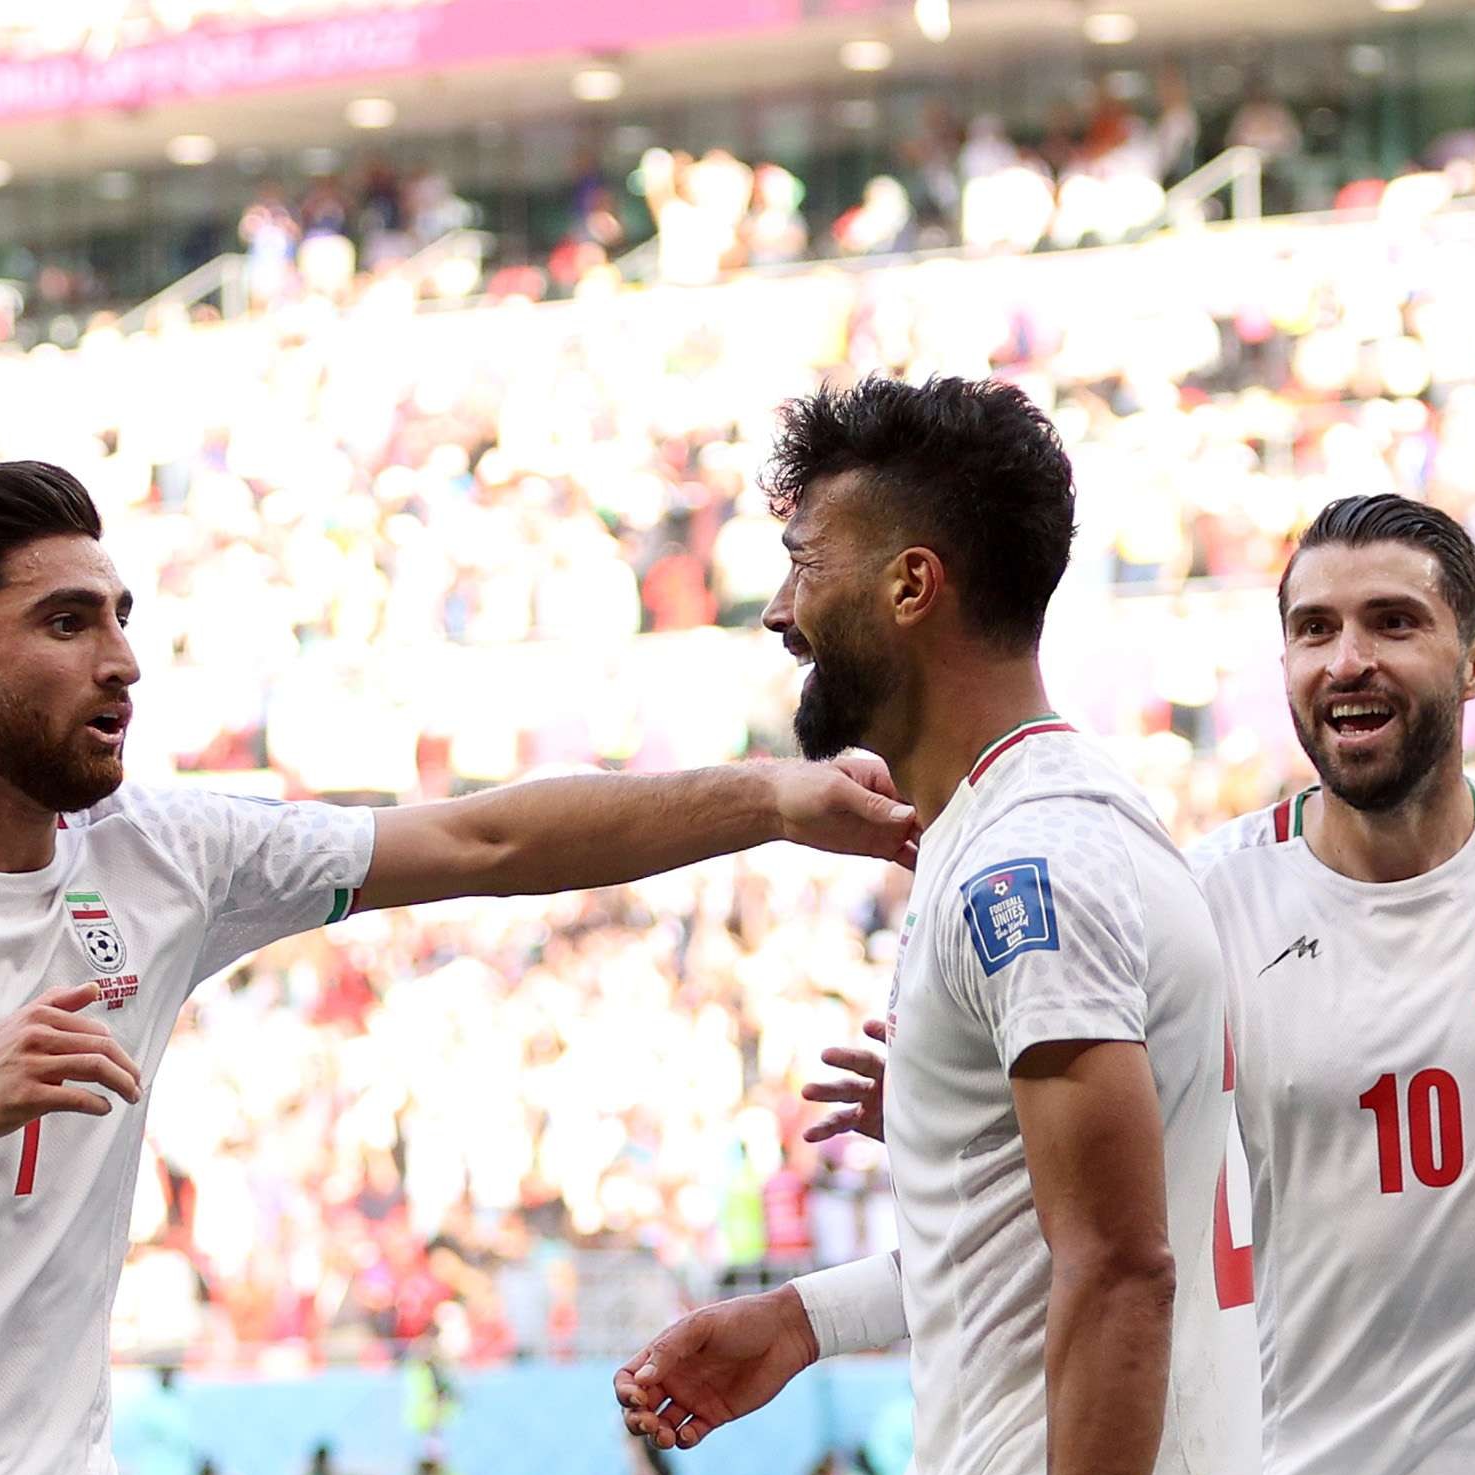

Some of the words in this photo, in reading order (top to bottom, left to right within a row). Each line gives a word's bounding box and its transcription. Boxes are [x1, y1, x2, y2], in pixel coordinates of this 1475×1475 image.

[989, 895, 1024, 916] FOOTBALL
[992, 903, 1026, 928] UNITES
[1359, 1067, 1464, 1194] 10
